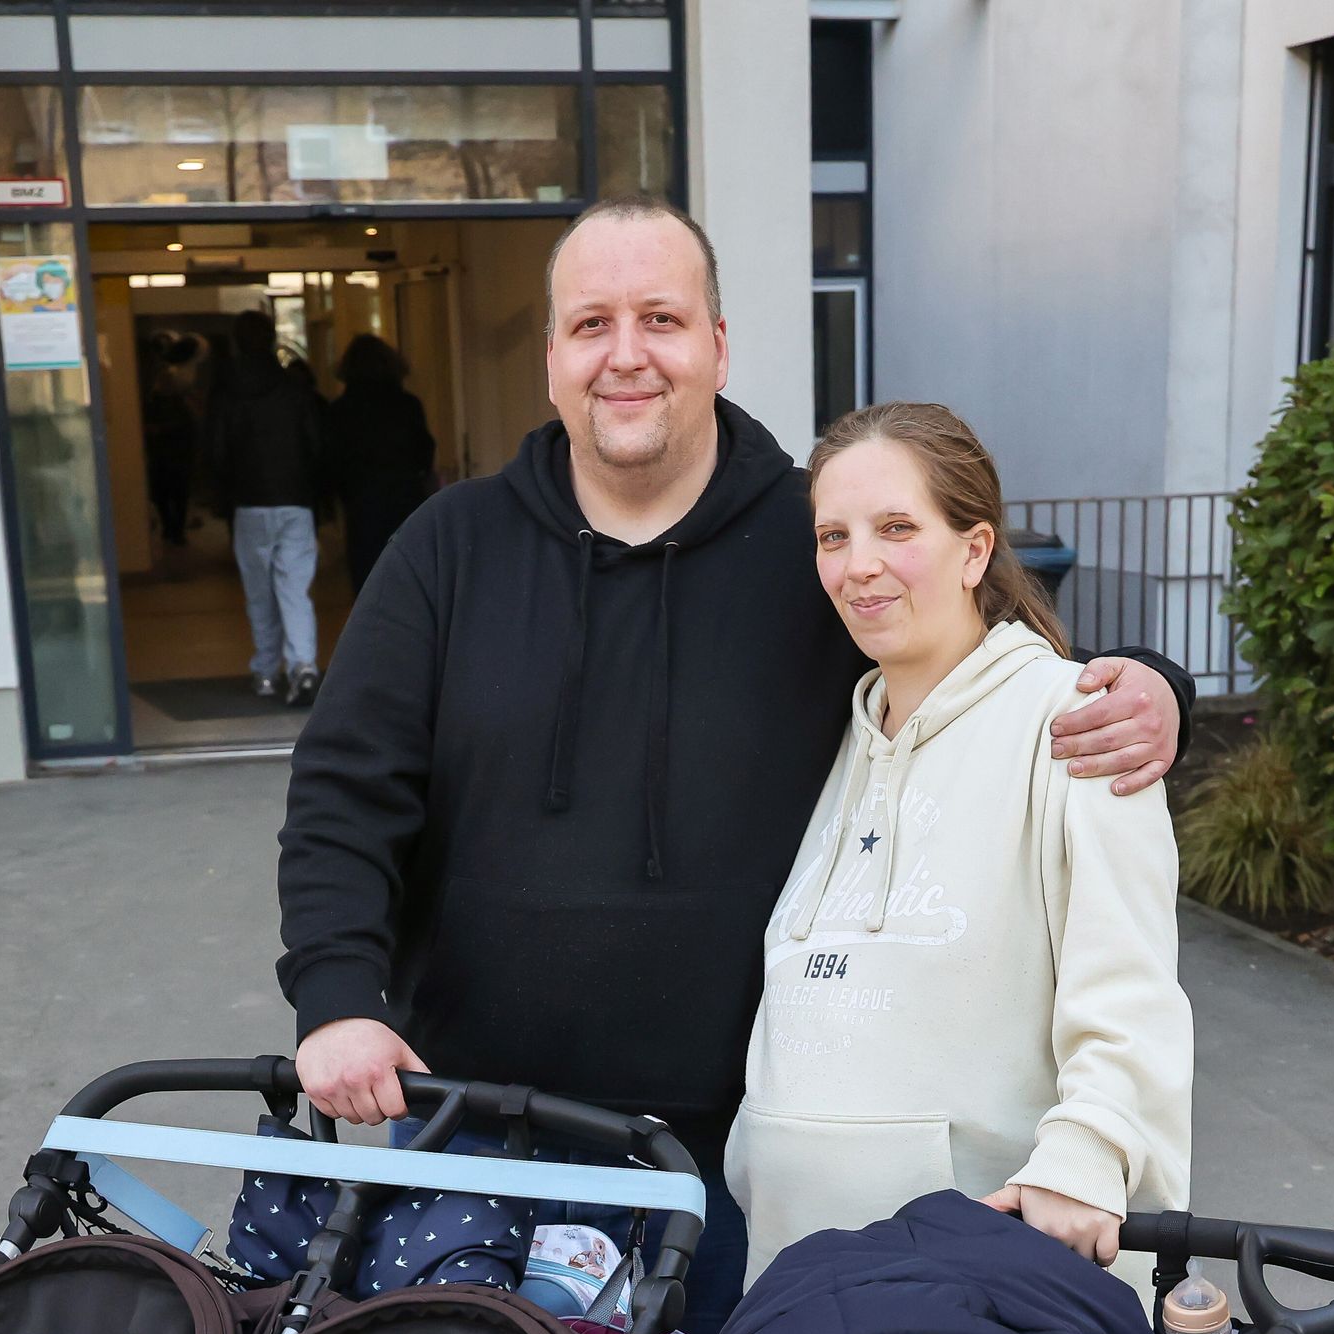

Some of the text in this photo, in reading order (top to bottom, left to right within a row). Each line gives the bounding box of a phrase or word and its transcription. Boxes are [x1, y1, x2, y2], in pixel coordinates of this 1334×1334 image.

[804, 953, 850, 980] 1994
[827, 986, 895, 1011] LEAGUE
[770, 1028, 809, 1055] SOCCER
